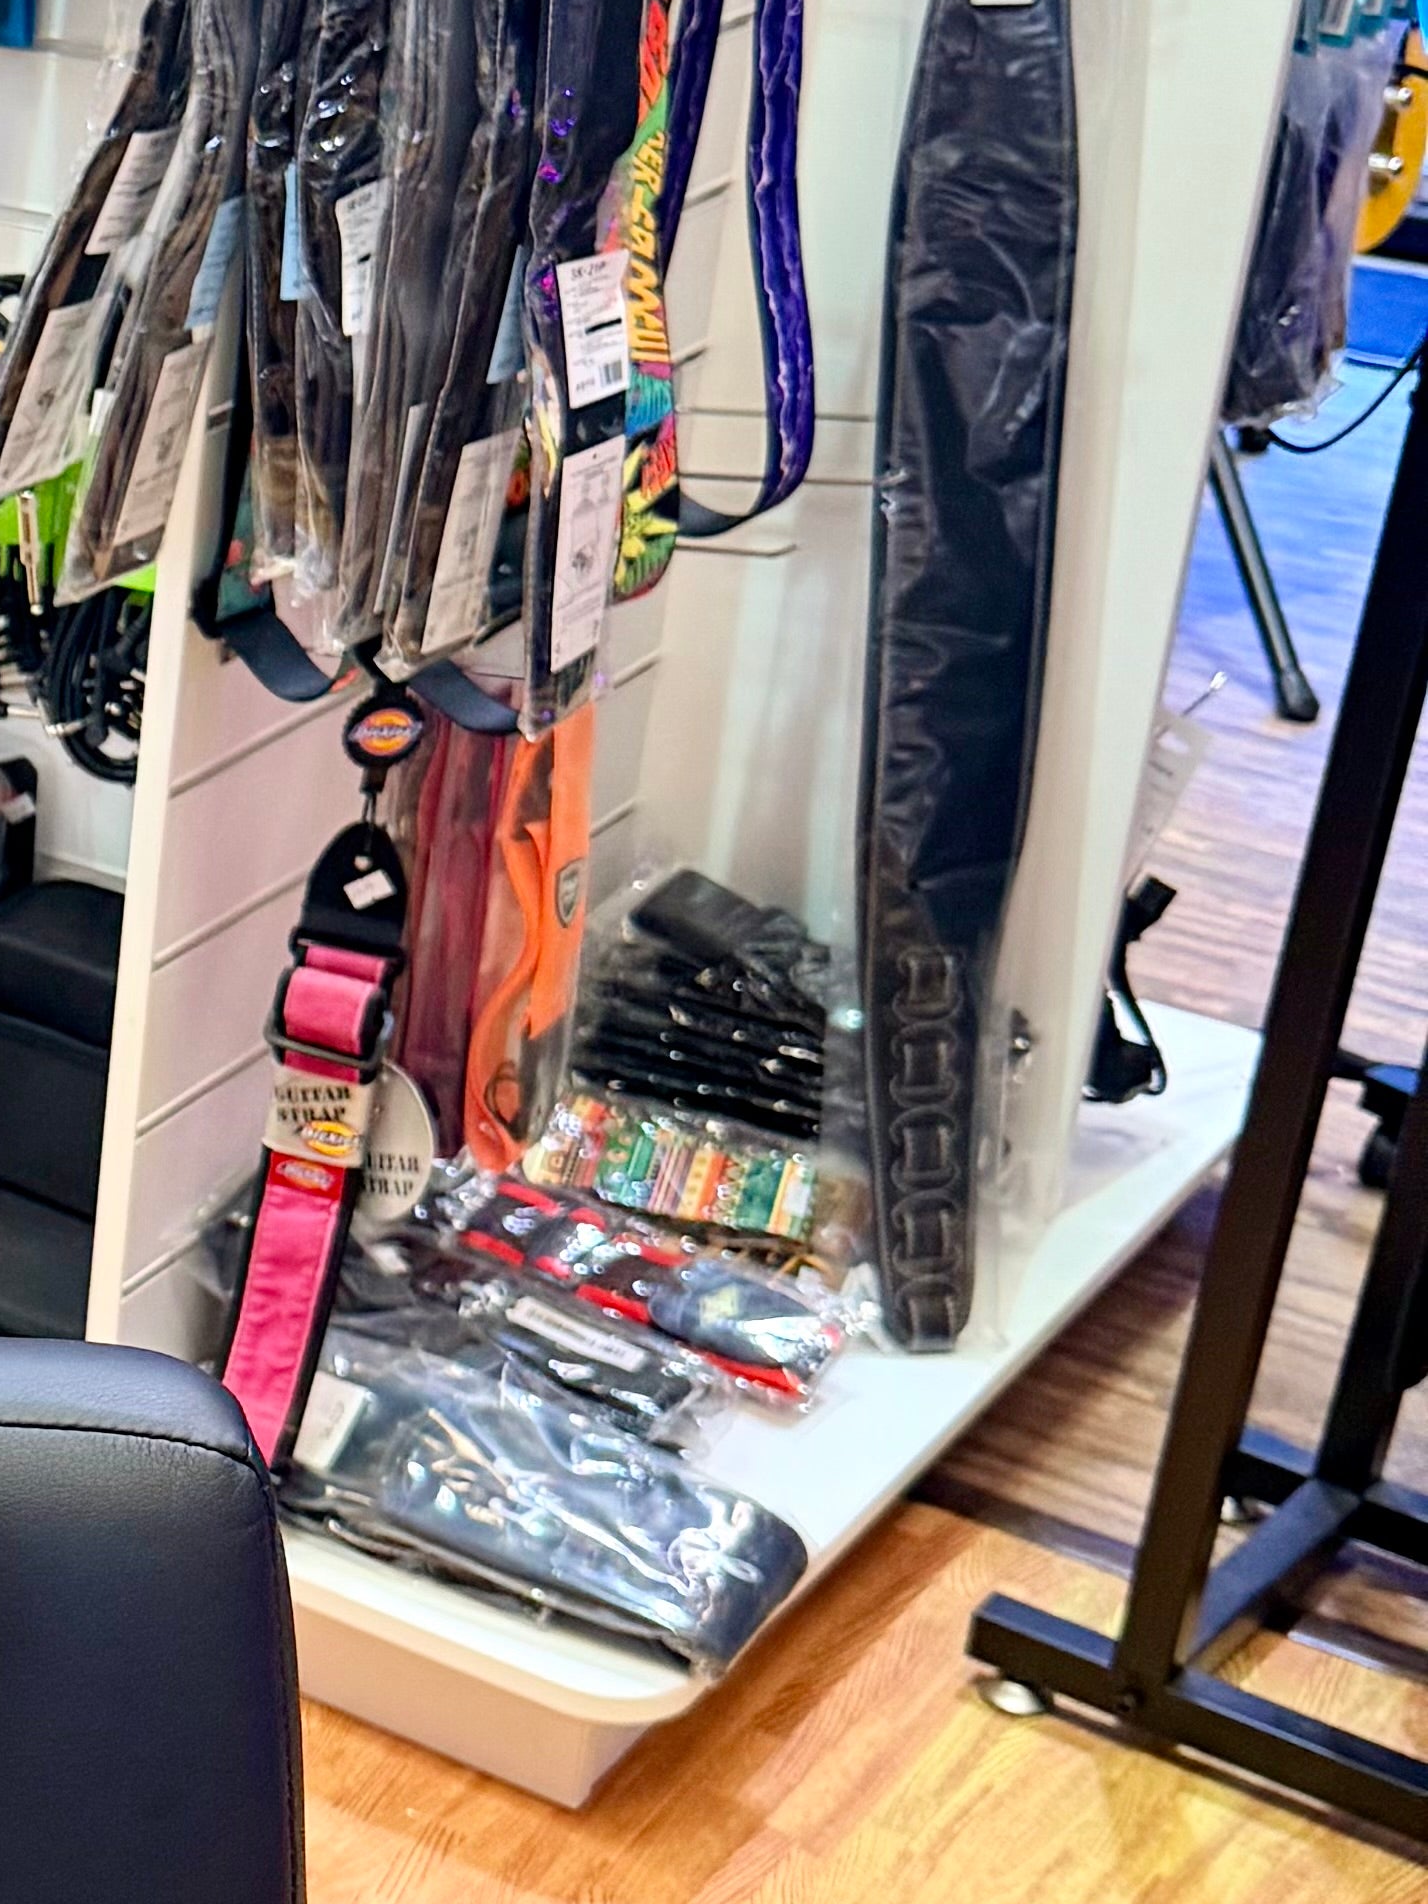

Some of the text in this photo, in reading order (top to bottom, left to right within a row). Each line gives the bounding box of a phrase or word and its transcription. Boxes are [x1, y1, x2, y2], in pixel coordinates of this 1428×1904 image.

[273, 1084, 352, 1102] GUITAR
[276, 1106, 347, 1124] STRAP
[365, 1152, 421, 1173] UITAR
